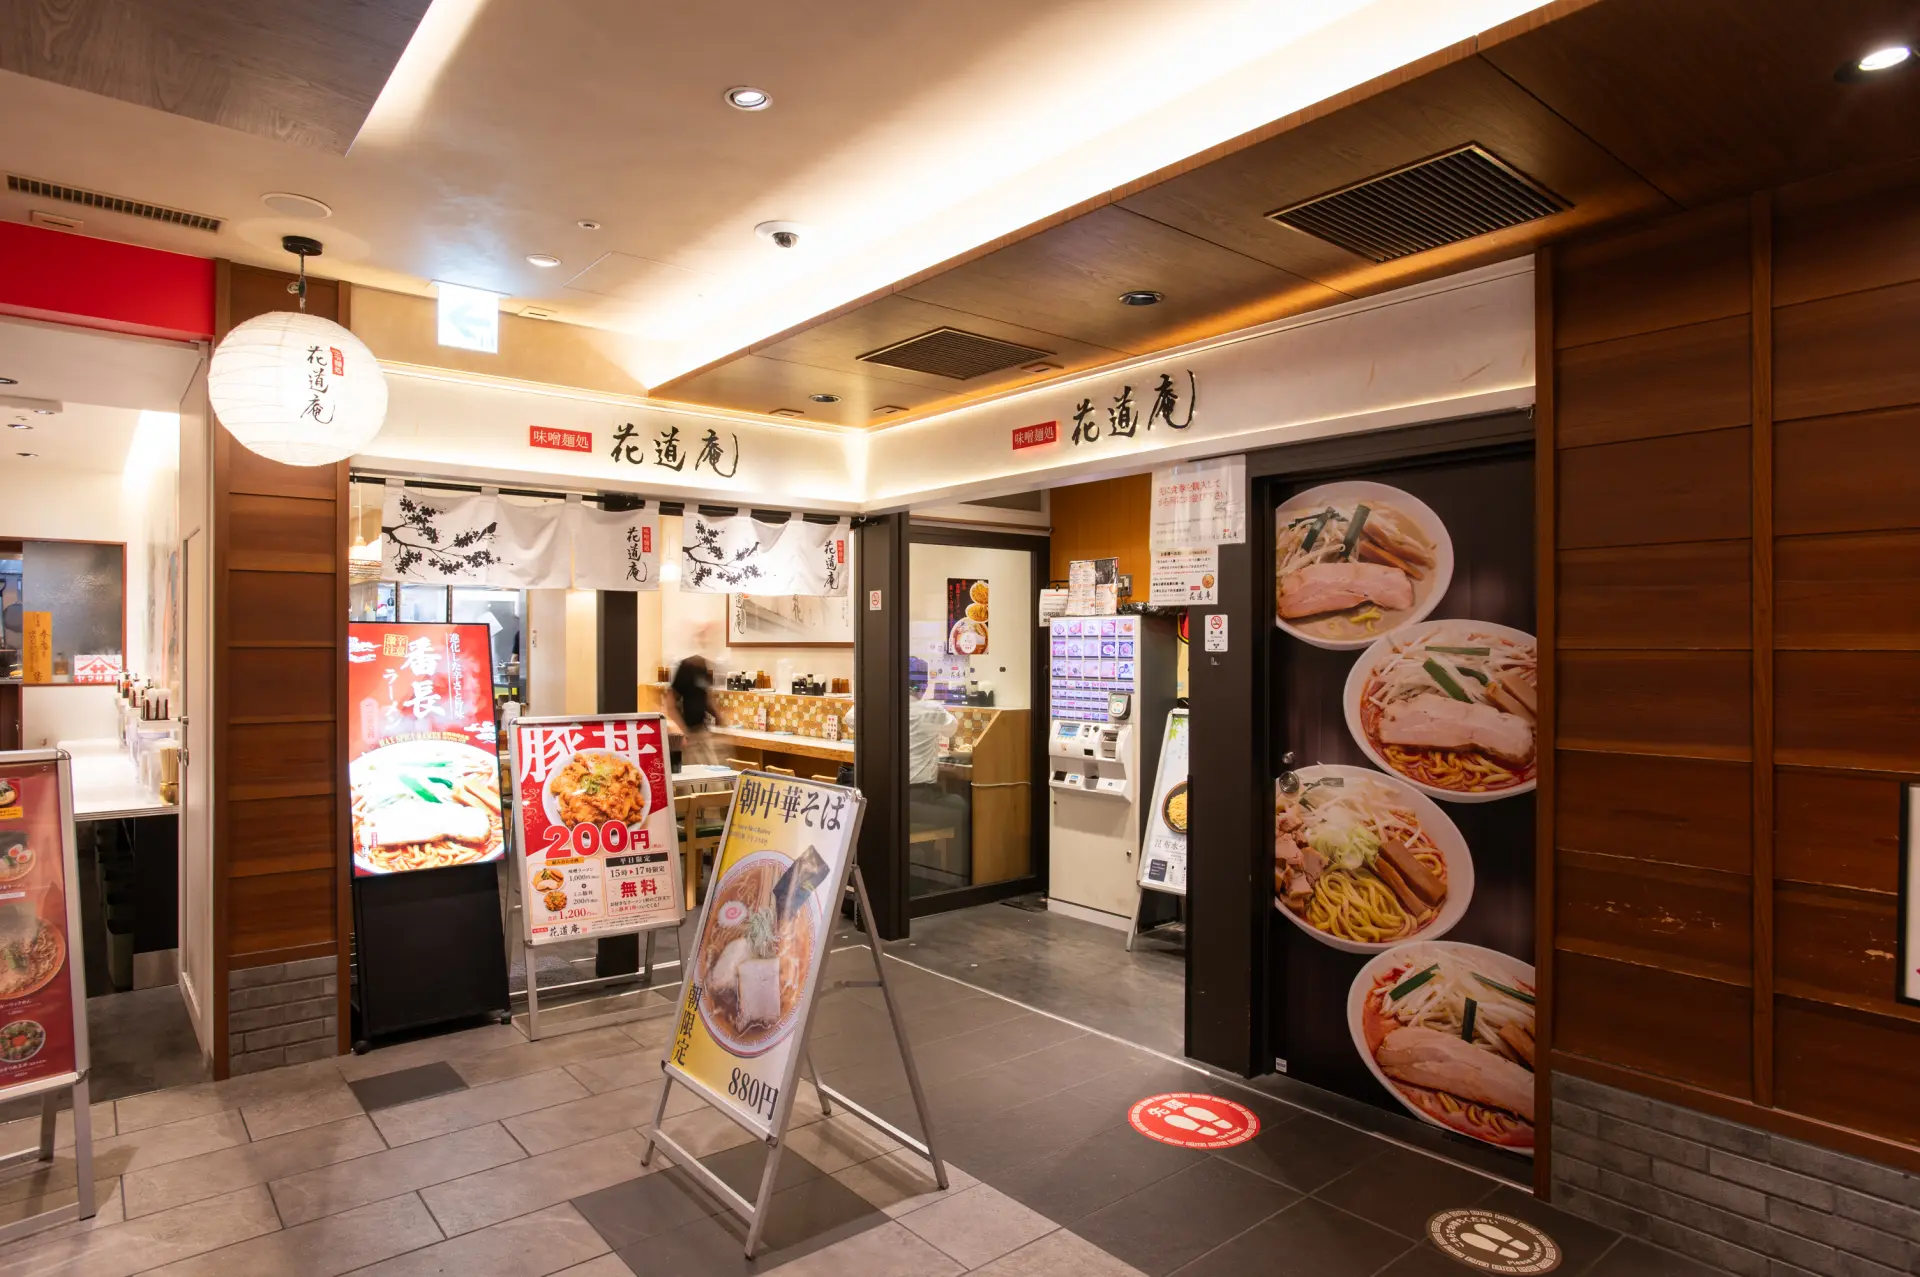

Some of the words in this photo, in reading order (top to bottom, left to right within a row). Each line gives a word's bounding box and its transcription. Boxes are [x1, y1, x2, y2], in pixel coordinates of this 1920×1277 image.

[300, 345, 336, 425] 花道庵
[1071, 369, 1196, 446] 花道庵
[532, 429, 590, 449] 味噌麺処
[610, 423, 739, 478] 花道庵
[1014, 424, 1054, 445] 味噌麺処
[626, 526, 648, 583] 花道庵
[824, 540, 840, 590] 花道庵
[383, 668, 401, 730] ラーメン
[521, 721, 657, 783] 豚丼
[738, 779, 846, 831] 朝中華そば
[543, 820, 650, 859] 200円
[620, 855, 651, 864] 平日限定
[620, 878, 658, 898] 無料
[549, 924, 581, 937] 花道庵
[673, 984, 703, 1066] 朝限定
[728, 1067, 780, 1121] 880円
[1146, 1098, 1188, 1118] 先頭
[1506, 1258, 1533, 1266] Please
